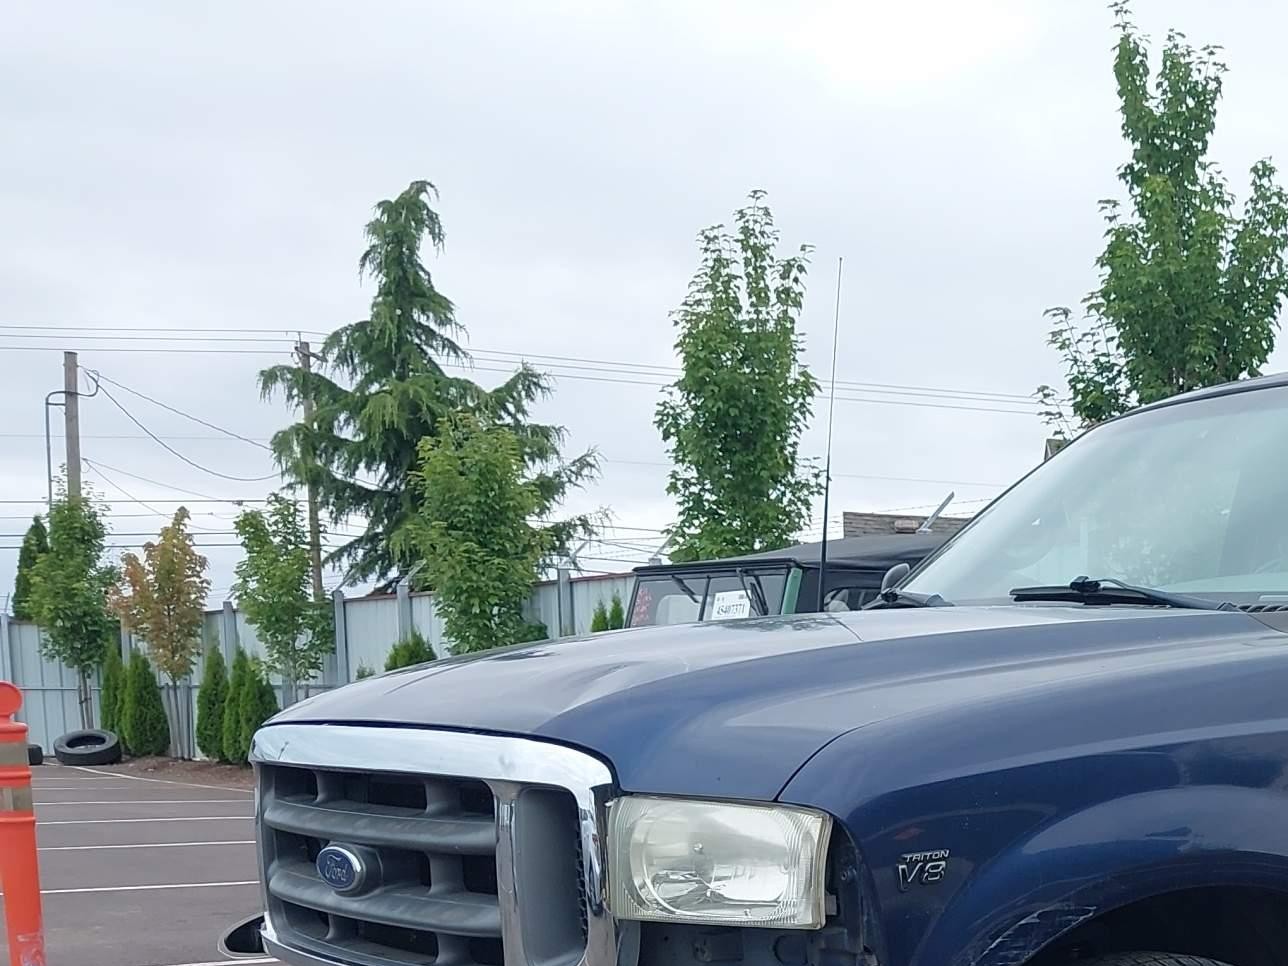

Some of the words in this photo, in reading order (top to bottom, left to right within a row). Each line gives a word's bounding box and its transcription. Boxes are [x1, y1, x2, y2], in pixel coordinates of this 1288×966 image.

[324, 854, 349, 882] Ford
[904, 849, 950, 863] TRITON
[897, 860, 947, 890] V8
